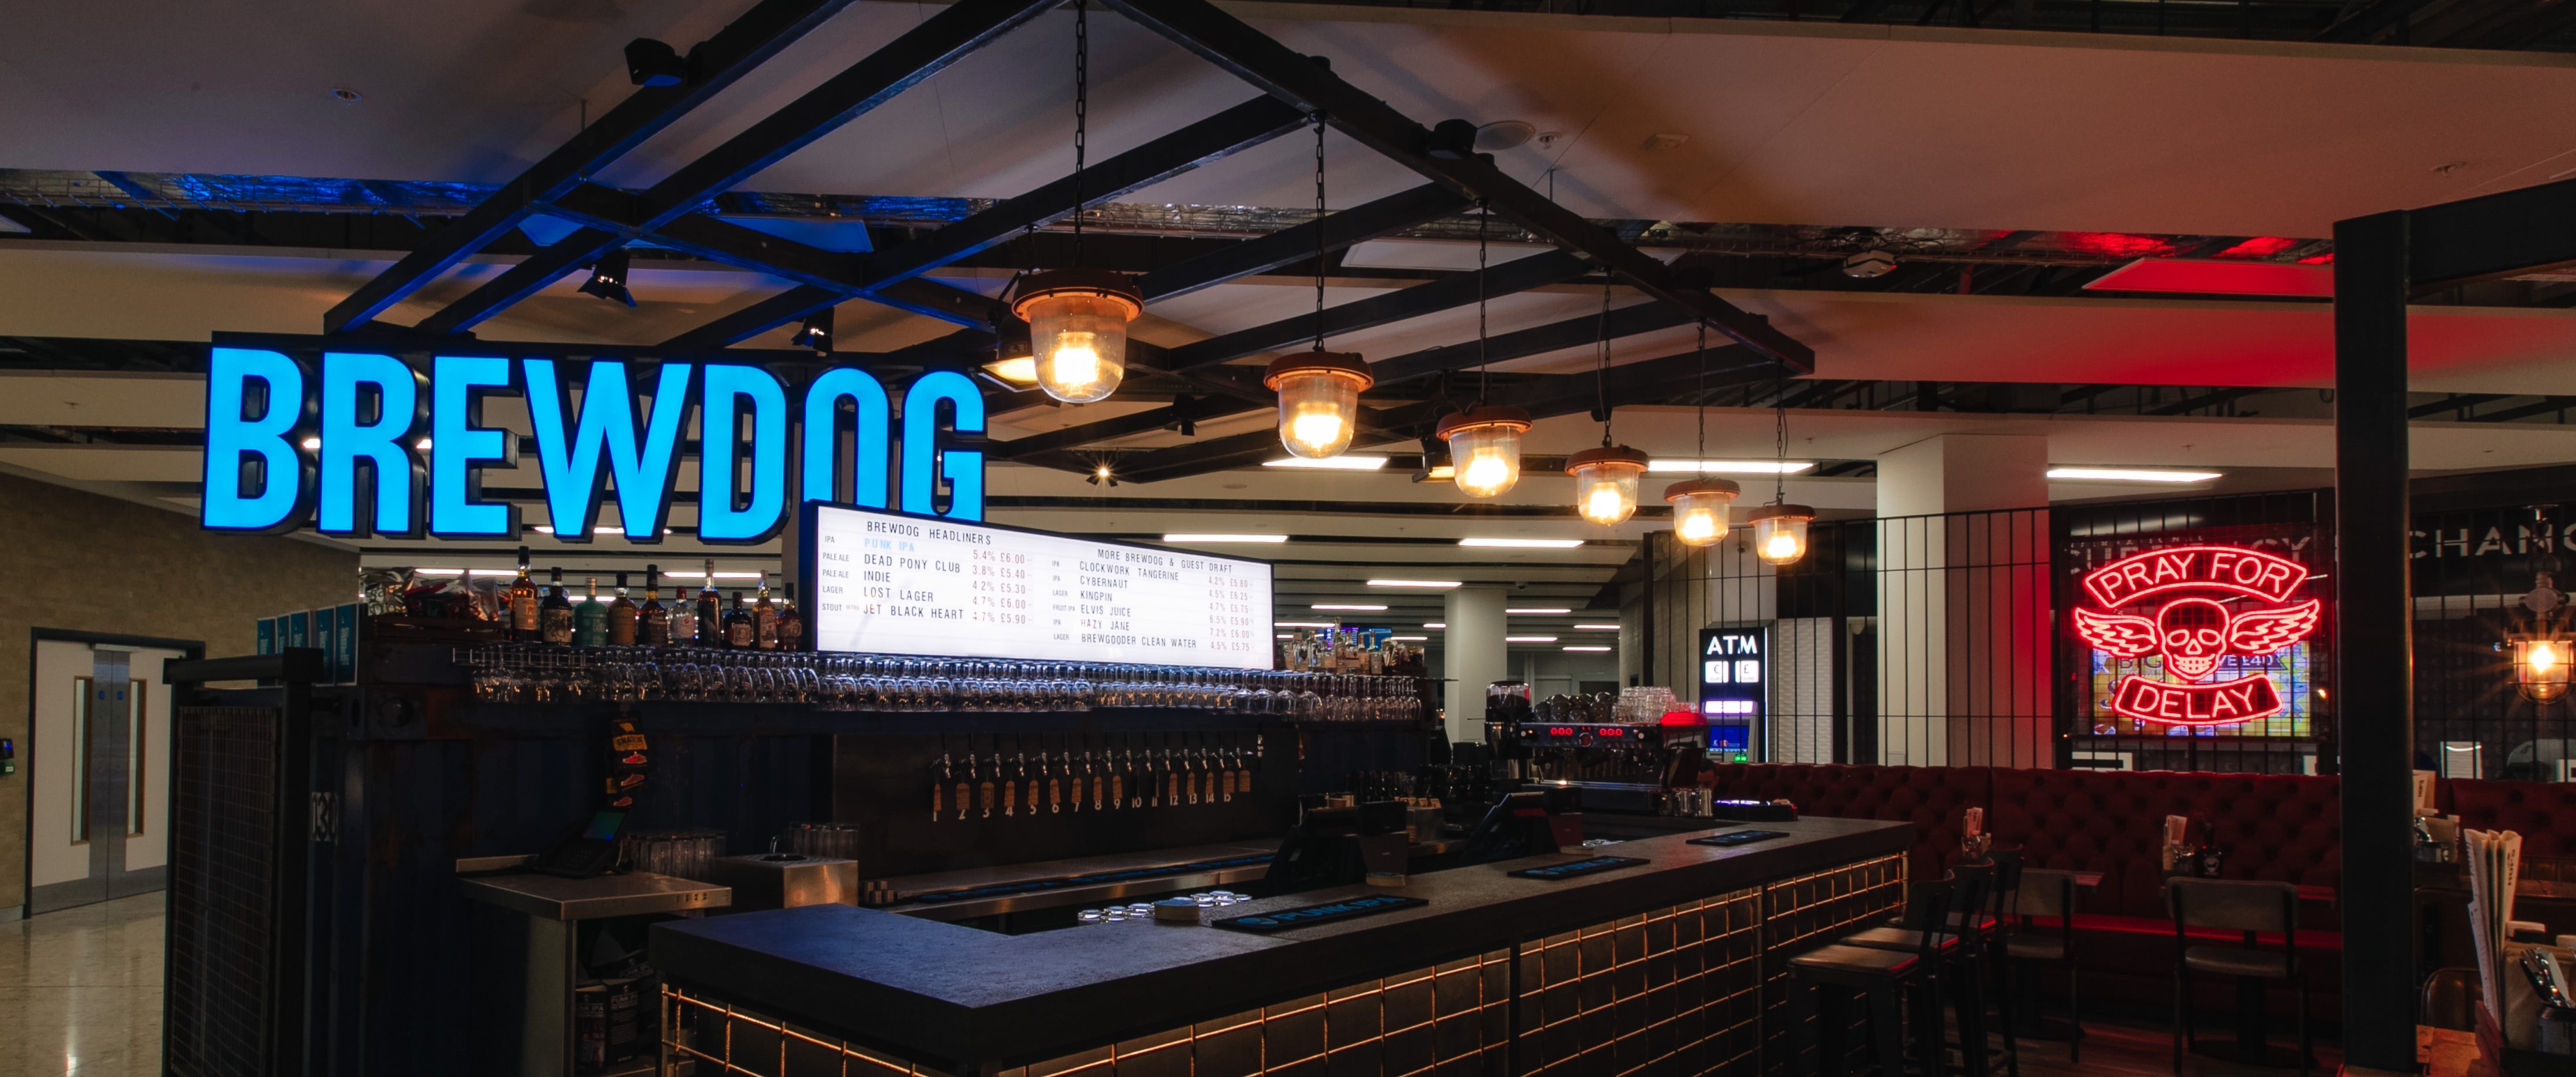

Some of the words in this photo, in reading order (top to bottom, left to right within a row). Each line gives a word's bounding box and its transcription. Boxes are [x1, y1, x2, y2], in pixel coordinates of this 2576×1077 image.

[204, 347, 984, 537] BREWDOG
[867, 521, 919, 537] BREWDOG
[930, 528, 991, 545] HEADLINERS
[825, 535, 835, 544] IPA
[865, 538, 891, 550] PUNK
[899, 541, 914, 553] IPA
[973, 550, 995, 562] 5.4%
[1001, 552, 1024, 564] £6.00
[1098, 549, 1120, 560] MORE
[1126, 553, 1163, 565] BREWDOG
[1169, 558, 1174, 567] &
[1182, 560, 1204, 570] GUEST
[1210, 563, 1232, 573] DRAFT
[823, 553, 837, 561] PALE
[839, 553, 849, 562] ALE
[865, 554, 892, 566] DEAD
[900, 558, 927, 570] PONY
[936, 560, 960, 573] CLUB
[1001, 567, 1024, 579] £5.40
[1080, 561, 1129, 576] CLOCKWORK
[1139, 568, 1179, 581] TANGERINE
[2099, 553, 2195, 599] PRAY
[2211, 553, 2290, 593] FOR
[822, 569, 837, 578] PALE
[838, 570, 849, 579] ALE
[864, 571, 890, 582] INDIE
[1001, 583, 1026, 594] £5.30
[1080, 576, 1128, 588] CYBERNAUT
[822, 586, 843, 594] LAGER
[864, 587, 890, 598] LOST
[900, 590, 934, 602] LAGER
[1001, 597, 1026, 609] £6.00
[1081, 590, 1112, 602] KINGPIN
[864, 604, 881, 615] JET
[891, 606, 923, 617] BLACK
[931, 609, 963, 620] HEART
[1001, 613, 1026, 624] £5.90
[1081, 604, 1103, 615] ELVIS
[1110, 607, 1131, 617] JUICE
[1081, 620, 1102, 629] HAZY
[1111, 622, 1129, 631] JANE
[1081, 633, 1136, 645] BREWGOODER
[1141, 636, 1166, 647] CLEAN
[1171, 638, 1196, 648] WATER
[1706, 635, 1758, 655] ATM
[2133, 685, 2253, 719] DELAY
[982, 807, 990, 818] 3
[1005, 806, 1014, 816] 4
[1051, 803, 1060, 814] 6
[1074, 802, 1080, 813] 7
[1095, 800, 1102, 811] 8
[1113, 798, 1120, 810] 9
[1132, 796, 1142, 809] 10
[1169, 795, 1178, 806] 12
[1189, 793, 1197, 804] 13
[1205, 793, 1214, 804] 14
[1224, 792, 1231, 802] 15
